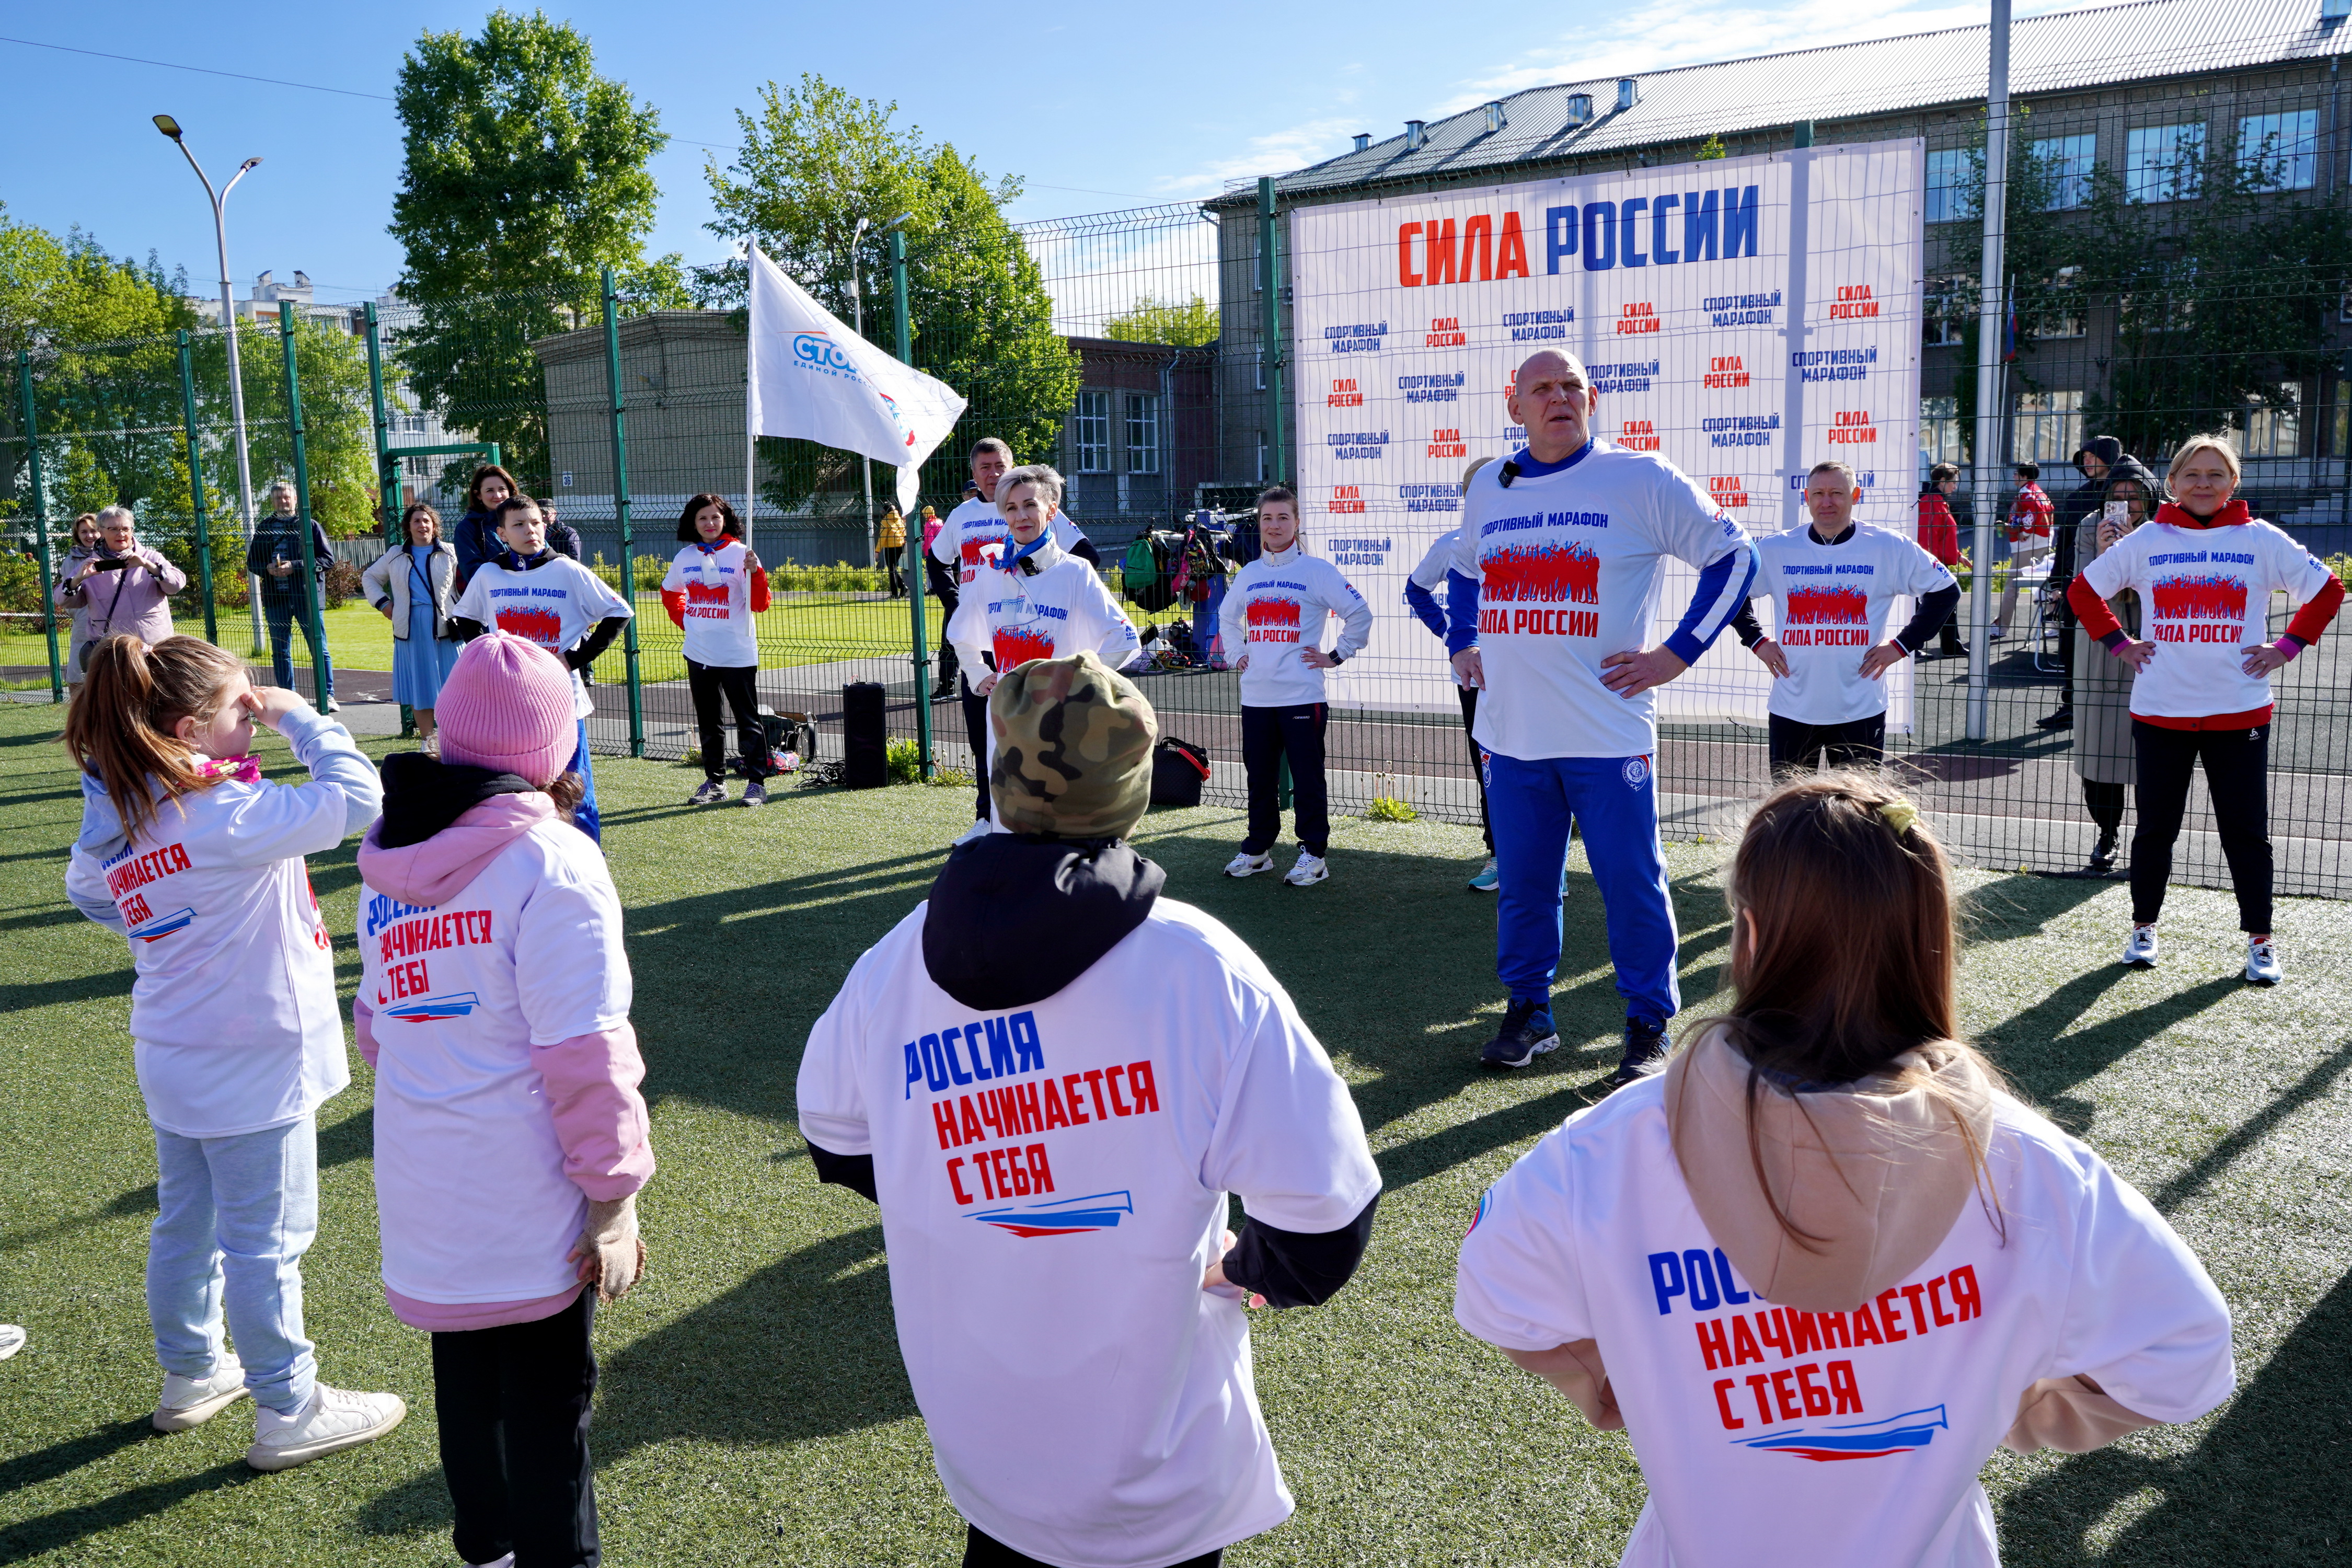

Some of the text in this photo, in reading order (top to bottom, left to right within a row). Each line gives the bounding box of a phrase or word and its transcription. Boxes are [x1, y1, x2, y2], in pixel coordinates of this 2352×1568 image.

[1399, 185, 1758, 287] СИЛА РОССИИ
[1838, 285, 1871, 301] СИЛА
[1703, 290, 1781, 313] СПОРТИВНЫЙ
[1503, 306, 1574, 327] СПОРТИВНЫЙ
[1623, 302, 1653, 318] СИЛА
[1713, 309, 1771, 327] МАРАФОН
[1830, 302, 1878, 319] РОССИИ
[1324, 320, 1387, 339] СПОРТИВНЫЙ
[1432, 317, 1459, 332] СИЛА
[1617, 318, 1659, 335] РОССИИ
[1426, 332, 1465, 348] РОССИИ
[1512, 325, 1565, 341] МАРАФОН
[1332, 338, 1380, 353] МАРАФОН
[1711, 356, 1742, 372] СИЛА
[1792, 346, 1876, 366] СПОРТИВНЫЙ
[794, 360, 837, 376] ЕДИНОЙ
[1586, 359, 1659, 379] СПОРТИВНЫЙ
[1802, 366, 1866, 383] МАРАФОН
[1333, 379, 1357, 392] СИЛА
[1398, 371, 1464, 389] СПОРТИВНЫЙ
[1594, 378, 1650, 394] МАРАФОН
[1704, 372, 1749, 389] РОССИИ
[1328, 393, 1363, 407] РОССИИ
[1407, 389, 1457, 403] МАРАФОН
[1702, 413, 1779, 432] СПОРТИВНЫЙ
[1835, 411, 1869, 426] СИЛА
[1434, 429, 1460, 443] СИЛА
[1623, 421, 1653, 435] СИЛА
[1828, 428, 1876, 444] РОССИИ
[1328, 429, 1389, 446] СПОРТИВНЫЙ
[1711, 431, 1770, 447] МАРАФОН
[1335, 446, 1381, 460] МАРАФОН
[1428, 443, 1466, 458] РОССИИ
[564, 476, 571, 485] 36
[1710, 477, 1740, 492] СИЛА
[1334, 486, 1359, 499] СИЛА
[1711, 493, 1747, 507] ОССИИ
[1329, 498, 1365, 514] РОССИИ
[1408, 498, 1457, 512] МАРАФОН
[1481, 512, 1608, 538] СПОРТИВНЫЙ МАРАФОН
[1329, 537, 1391, 552] СПОРТИВНЫЙ
[1335, 551, 1383, 566] МАРАФОН
[2211, 552, 2254, 565] МАРАФОН
[1783, 564, 1874, 575] СПОРТИВНЫЙ МАРАФОН
[532, 588, 567, 598] МАРАФОН
[1277, 581, 1306, 592] МАРАФОН
[697, 607, 729, 619] РОССИИ
[1515, 609, 1598, 638] РОССИИ
[1263, 630, 1300, 643] РОССИИ
[1782, 629, 1869, 646] СИЛА РОССИИ
[106, 843, 192, 901] НАЧИНАЕТСЯ
[379, 910, 492, 966] НАЧИНАЕТСЯ
[904, 1010, 1045, 1100] РОССИЯ
[932, 1060, 1159, 1150] НАЧИНАЕТСЯ
[946, 1143, 1055, 1205] С ТЕБЯ
[1695, 1264, 1981, 1371] НАЧИНАЕТСЯ
[1713, 1360, 1864, 1430] С ТЕБЯ
